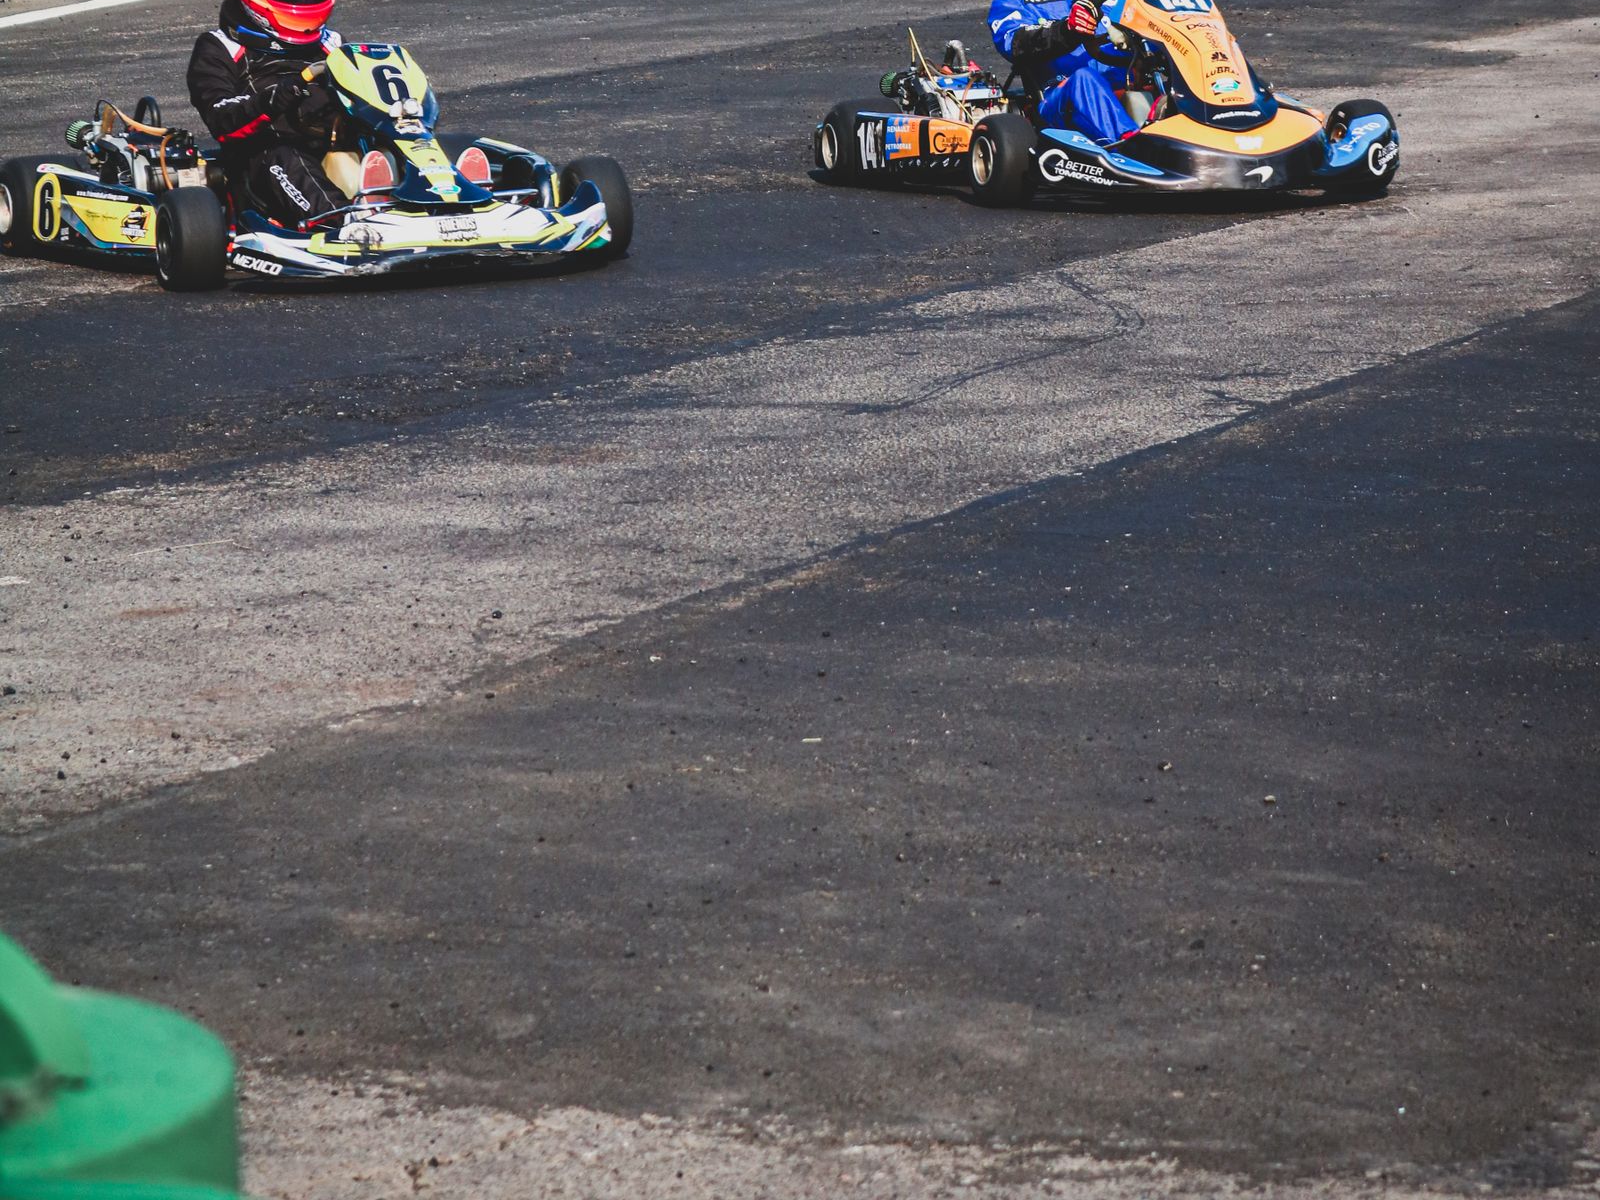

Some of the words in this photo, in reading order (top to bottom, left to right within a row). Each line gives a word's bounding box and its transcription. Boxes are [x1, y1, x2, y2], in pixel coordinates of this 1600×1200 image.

[1147, 20, 1172, 43] RICHARD
[1171, 38, 1189, 57] MILLE
[371, 64, 412, 106] 6
[886, 125, 910, 134] RENAULT
[1337, 122, 1381, 152] FxPro
[1054, 167, 1116, 186] TOMORROW
[1056, 159, 1065, 168] A
[1065, 160, 1104, 177] BETTER
[39, 180, 55, 238] 6
[232, 253, 284, 276] MEXICO
